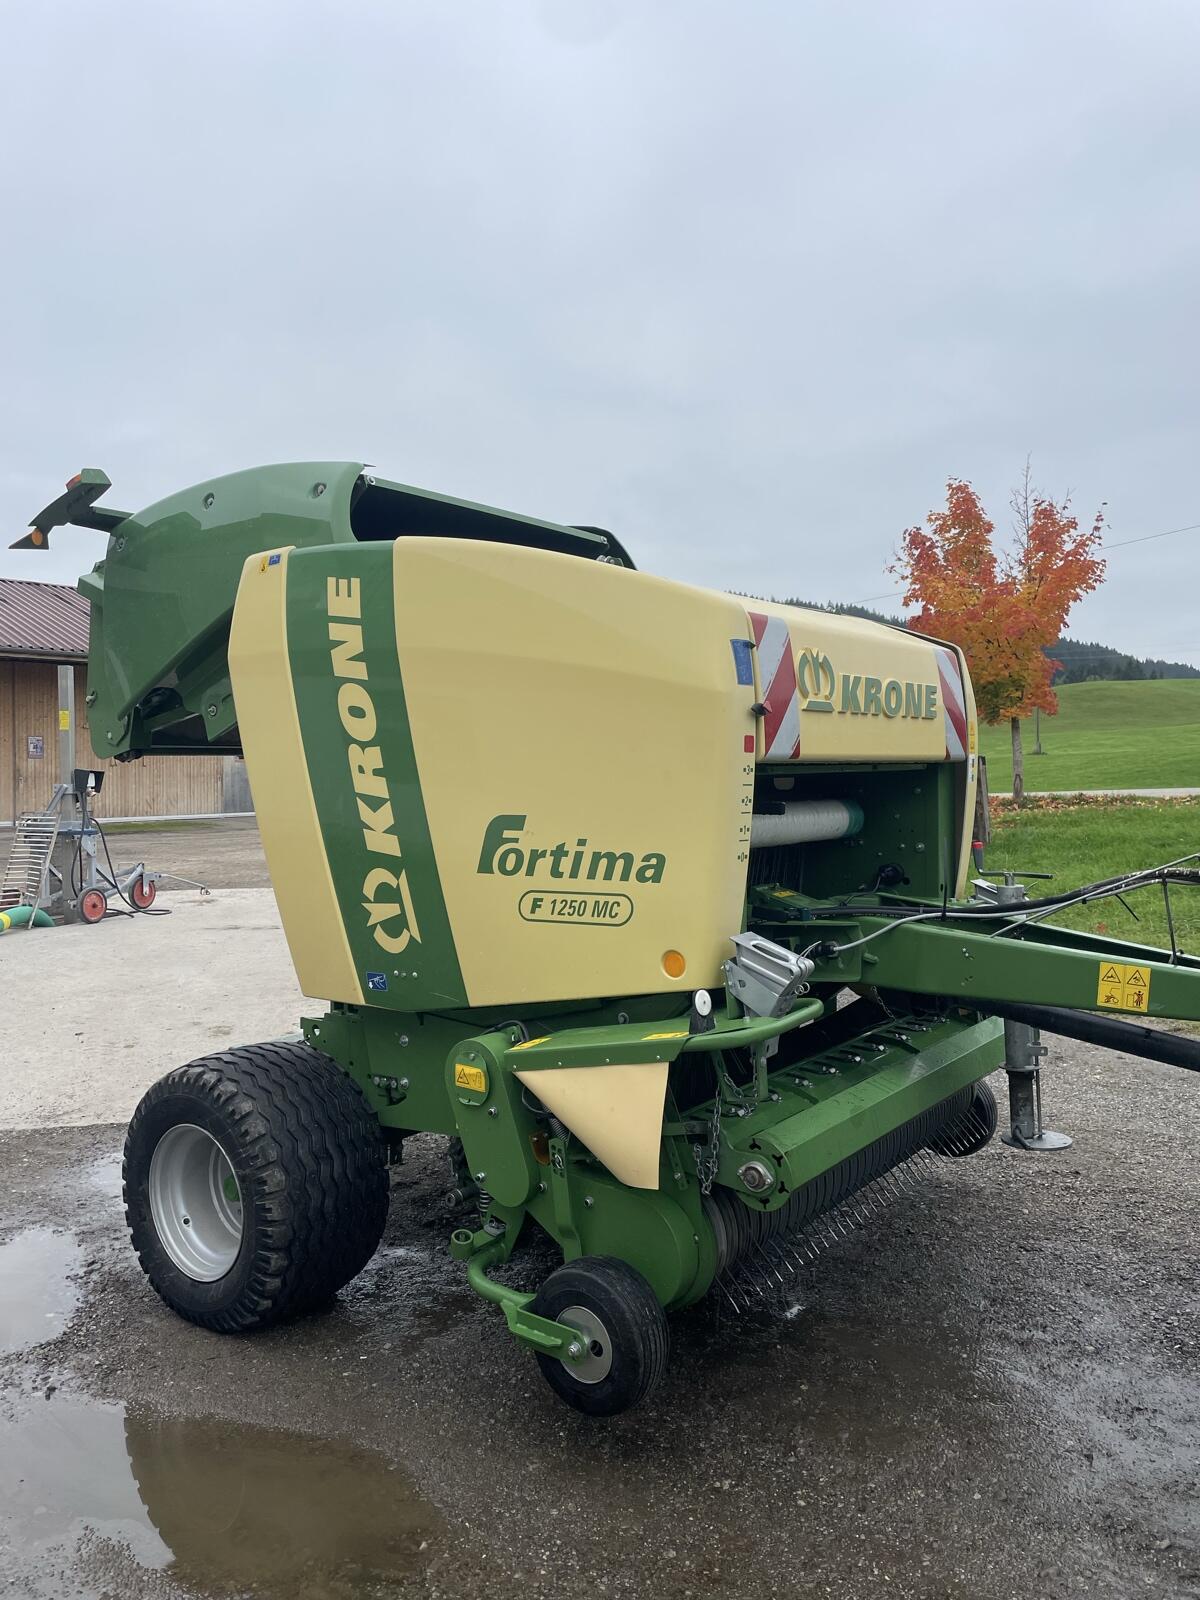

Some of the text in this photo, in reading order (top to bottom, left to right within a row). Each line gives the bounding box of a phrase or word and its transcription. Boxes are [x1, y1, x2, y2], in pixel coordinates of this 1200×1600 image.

[327, 576, 401, 857] KRONE
[838, 674, 937, 720] KRONE
[476, 814, 666, 884] Fortima
[529, 897, 621, 919] F 1250 MC
